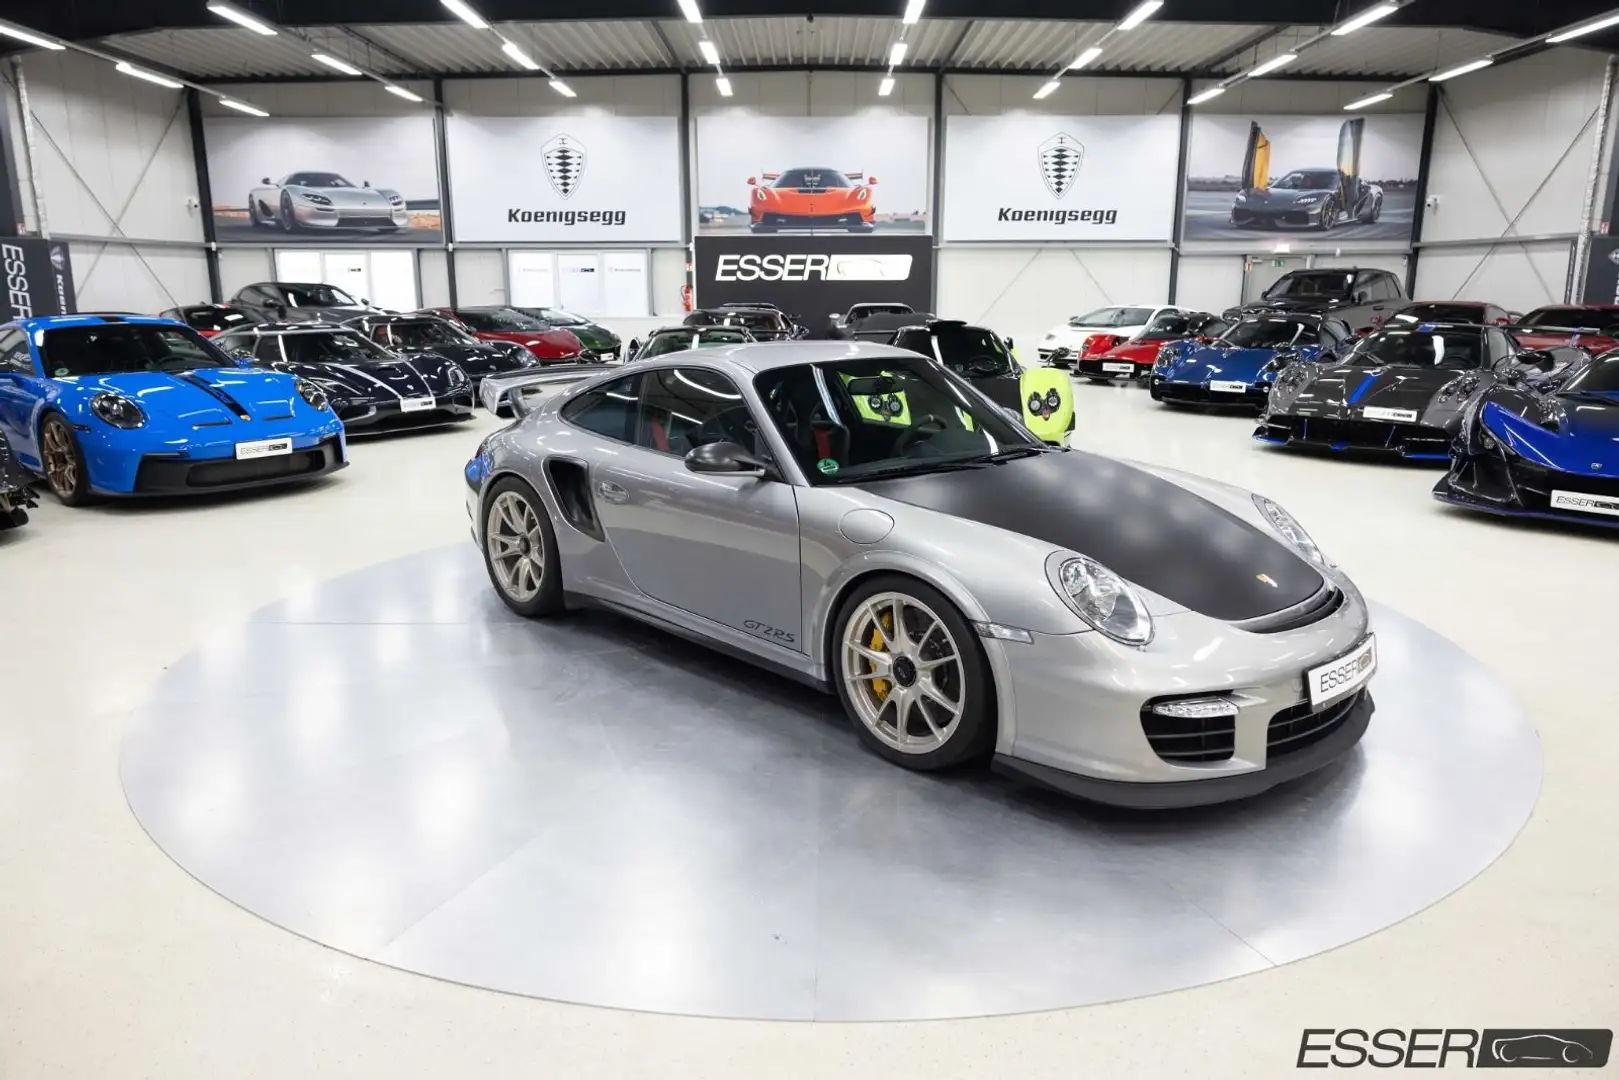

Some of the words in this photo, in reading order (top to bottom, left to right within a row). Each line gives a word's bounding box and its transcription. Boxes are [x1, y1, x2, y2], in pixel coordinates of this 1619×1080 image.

[507, 208, 626, 226] Koenigsegg
[998, 207, 1118, 225] Koenigsegg
[715, 254, 829, 281] ESSER
[1, 243, 32, 319] ESSER
[1556, 496, 1595, 507] ESSER
[1320, 659, 1359, 693] ESSER
